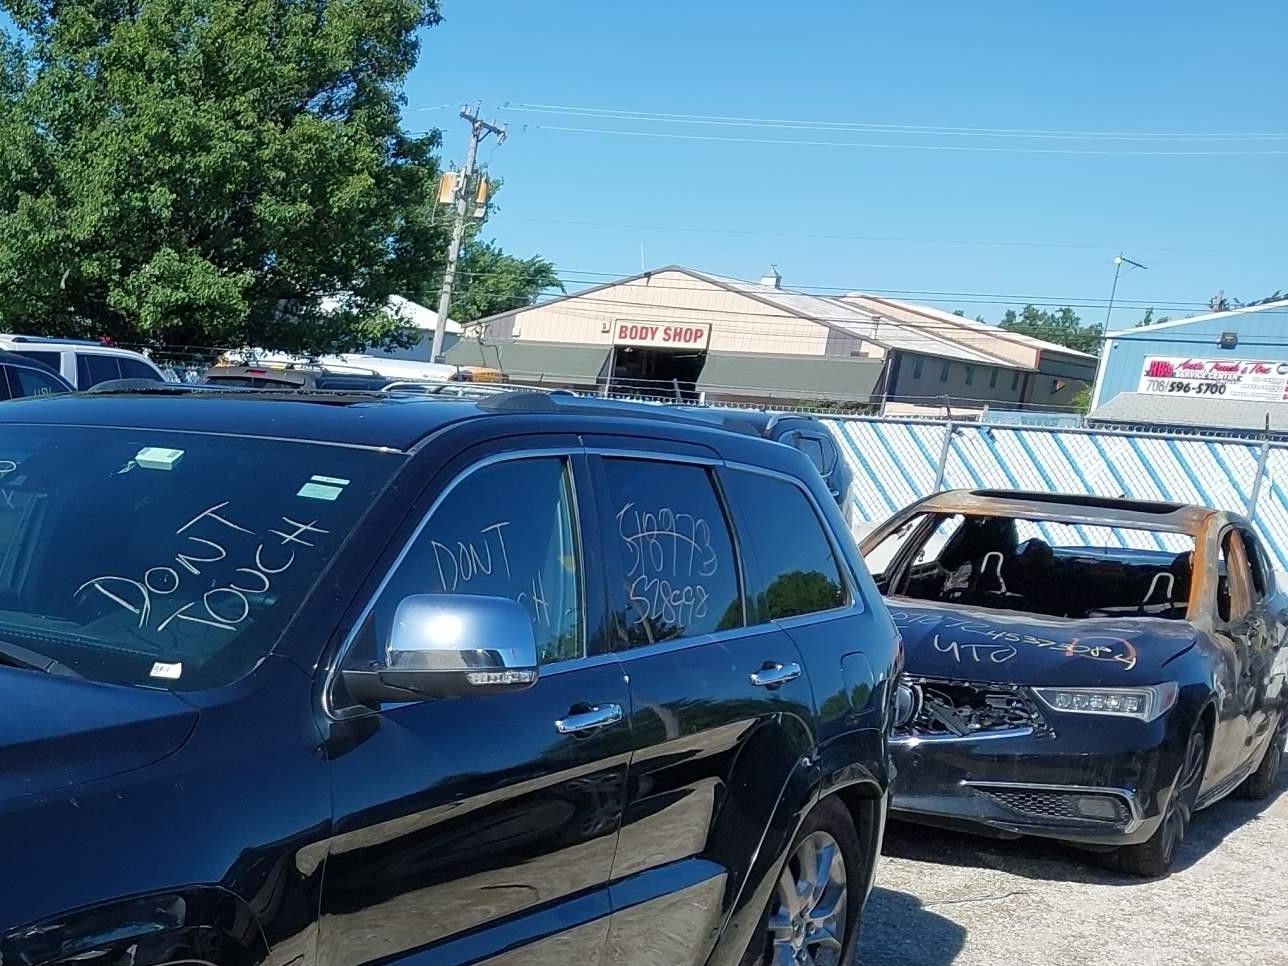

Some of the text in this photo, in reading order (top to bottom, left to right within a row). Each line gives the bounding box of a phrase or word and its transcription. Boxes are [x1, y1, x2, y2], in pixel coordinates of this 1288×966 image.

[618, 325, 704, 343] BODY SHOP
[1146, 380, 1227, 395] 708/596-5700
[73, 500, 257, 629] DONT
[157, 515, 330, 631] TOUCH
[430, 521, 511, 591] DONT
